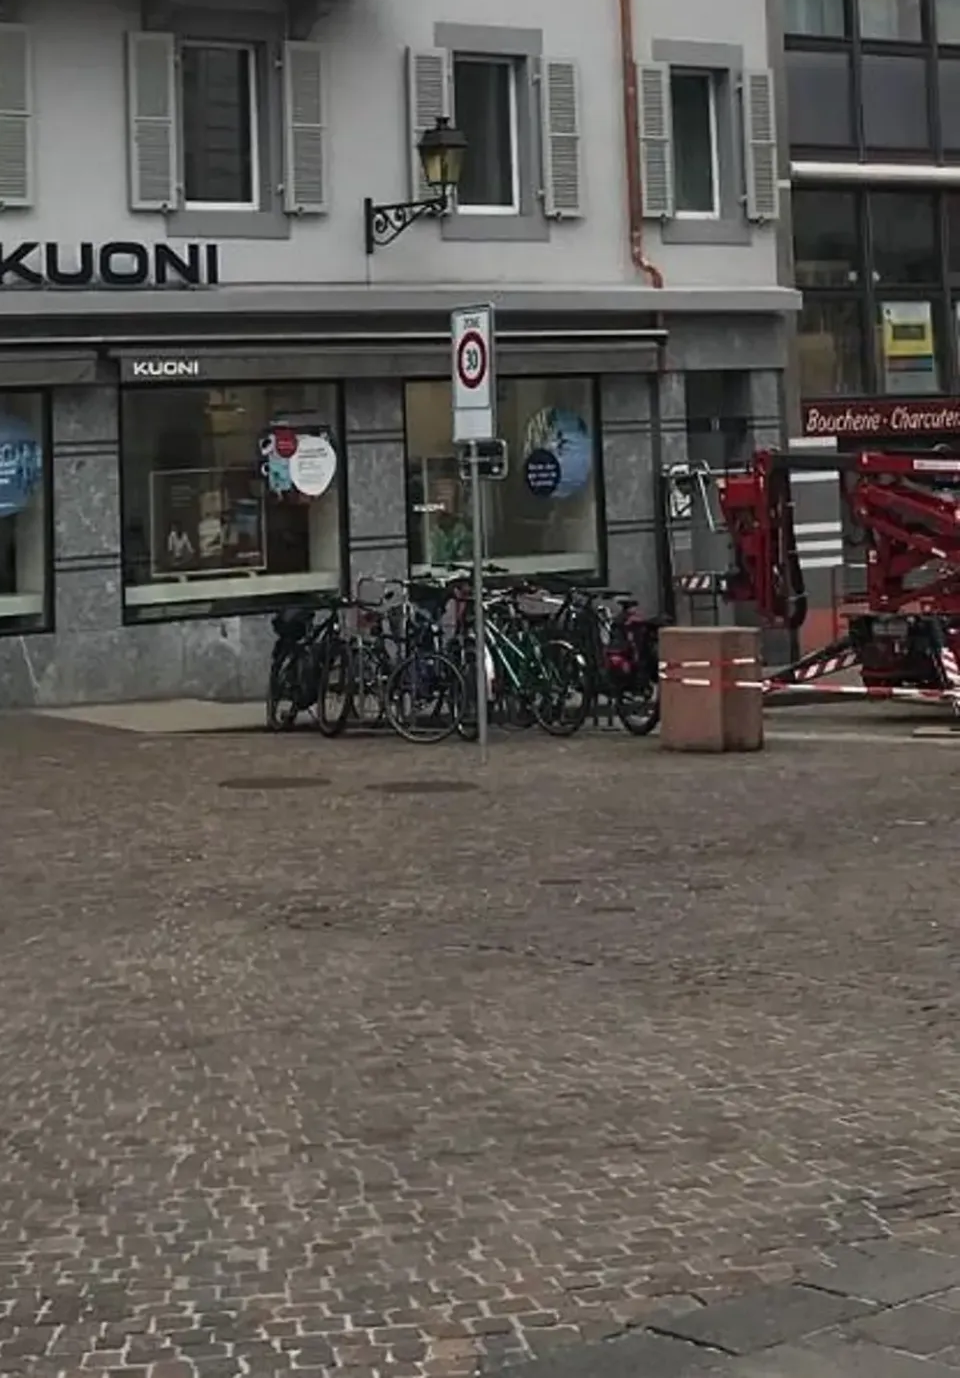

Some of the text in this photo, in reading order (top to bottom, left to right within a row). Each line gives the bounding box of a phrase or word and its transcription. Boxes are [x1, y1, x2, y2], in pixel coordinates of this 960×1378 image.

[133, 361, 198, 375] KUONI
[465, 349, 479, 372] 30
[806, 408, 881, 432] Boucherie
